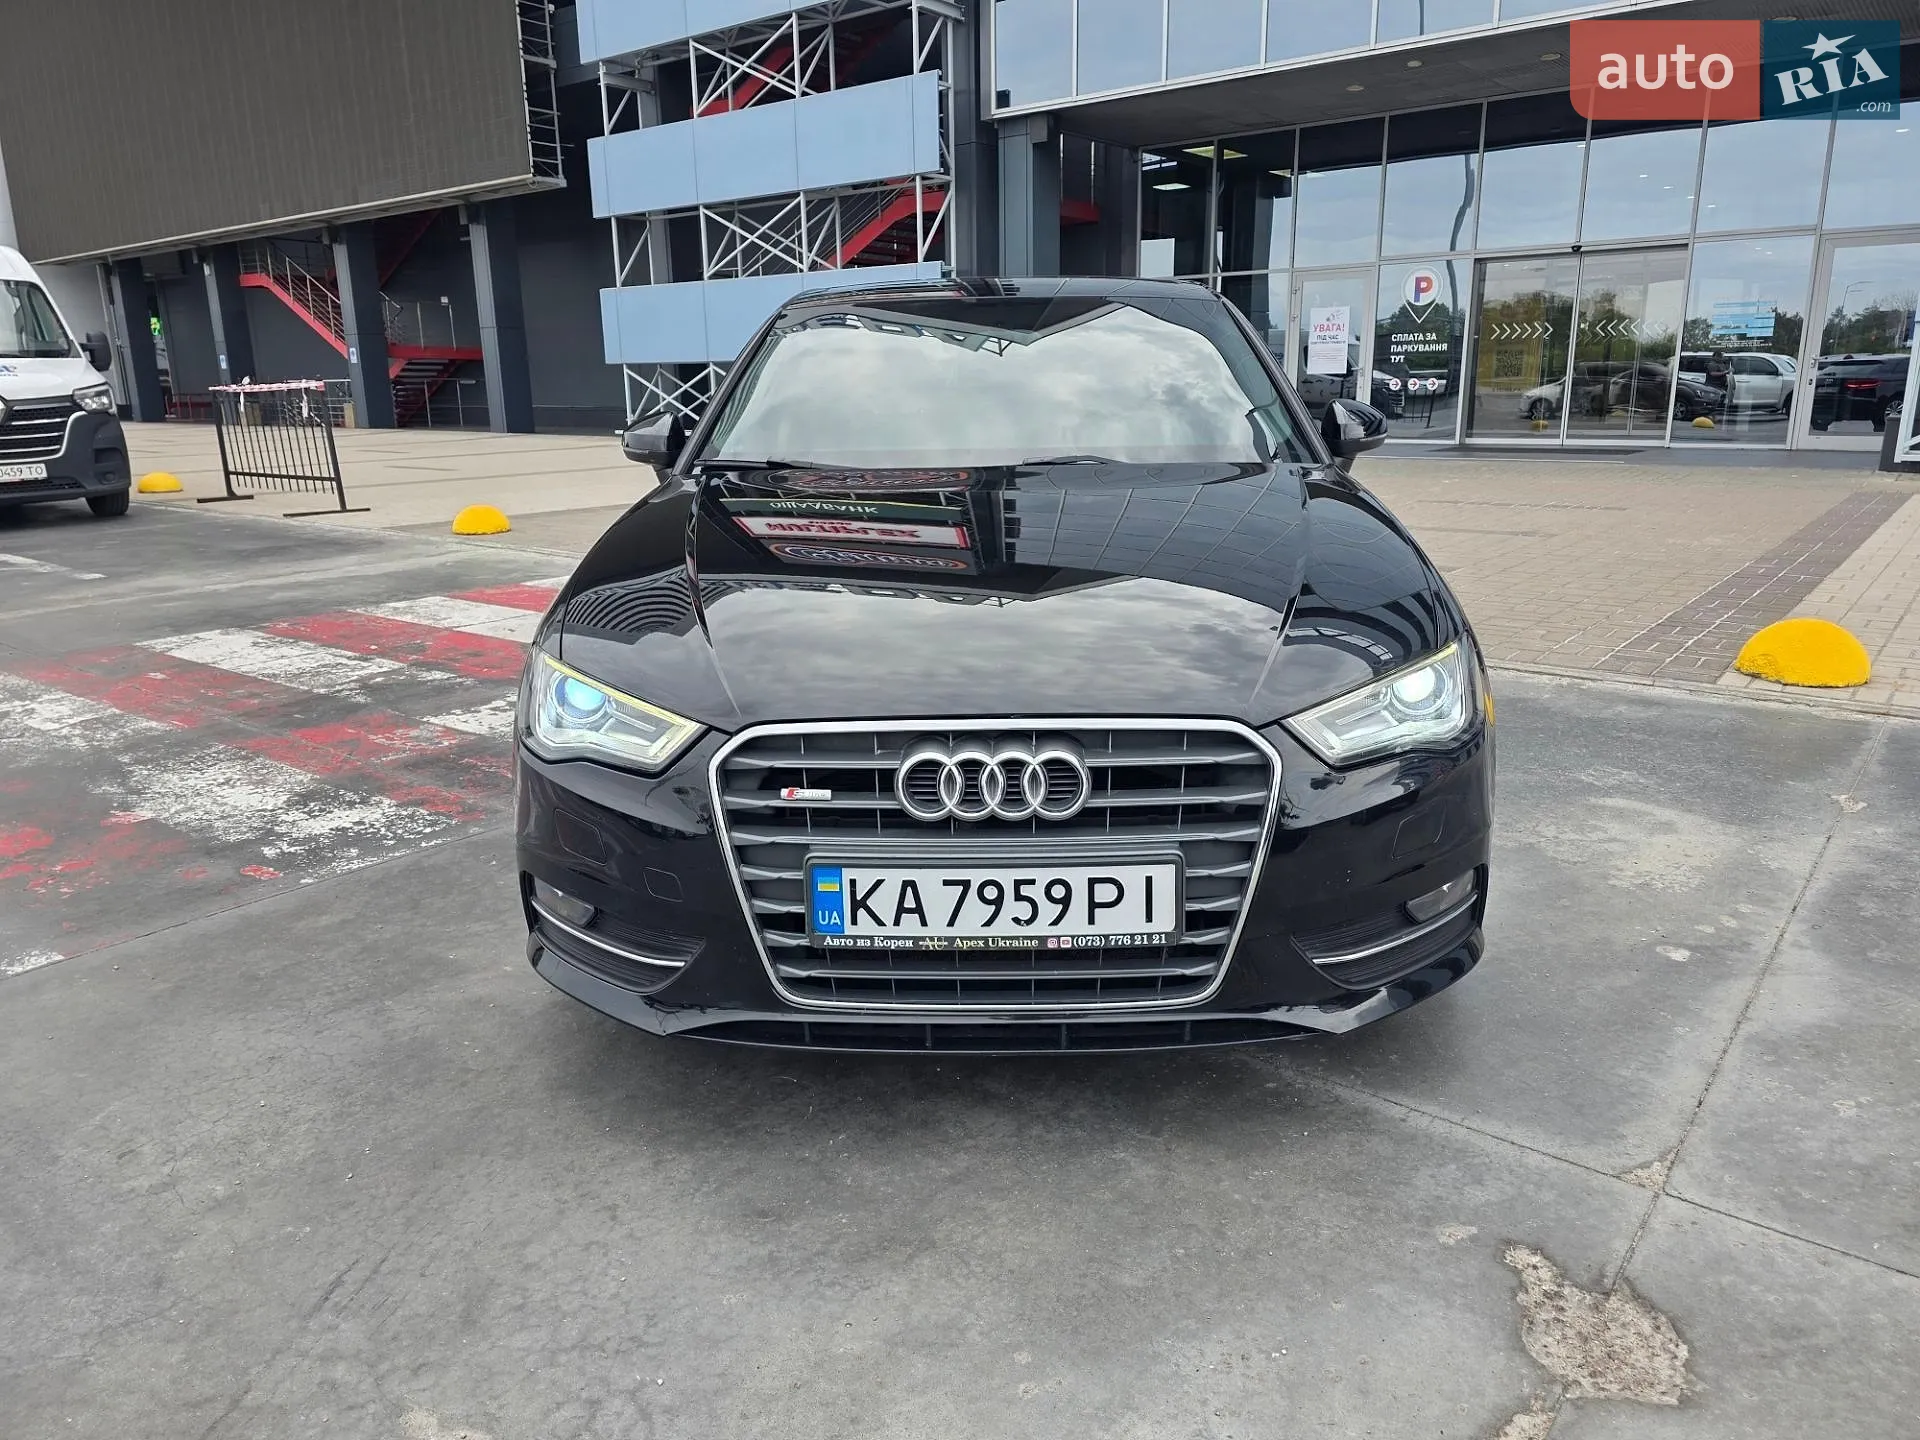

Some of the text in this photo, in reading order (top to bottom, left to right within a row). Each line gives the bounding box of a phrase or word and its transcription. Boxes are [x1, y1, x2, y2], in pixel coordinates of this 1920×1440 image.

[1313, 323, 1345, 332] УВАГА!
[1391, 332, 1437, 342] СПЛАТА ЗА
[1390, 343, 1448, 353] ПАРКУВАННЯ
[1390, 355, 1405, 363] ТУТ
[942, 876, 1074, 929] 7959
[818, 911, 841, 926] UA
[823, 936, 853, 947] Авто
[856, 938, 871, 947] из
[954, 937, 1039, 950] Apex Ukraine
[1073, 933, 1167, 948] (073) 776 21 21
